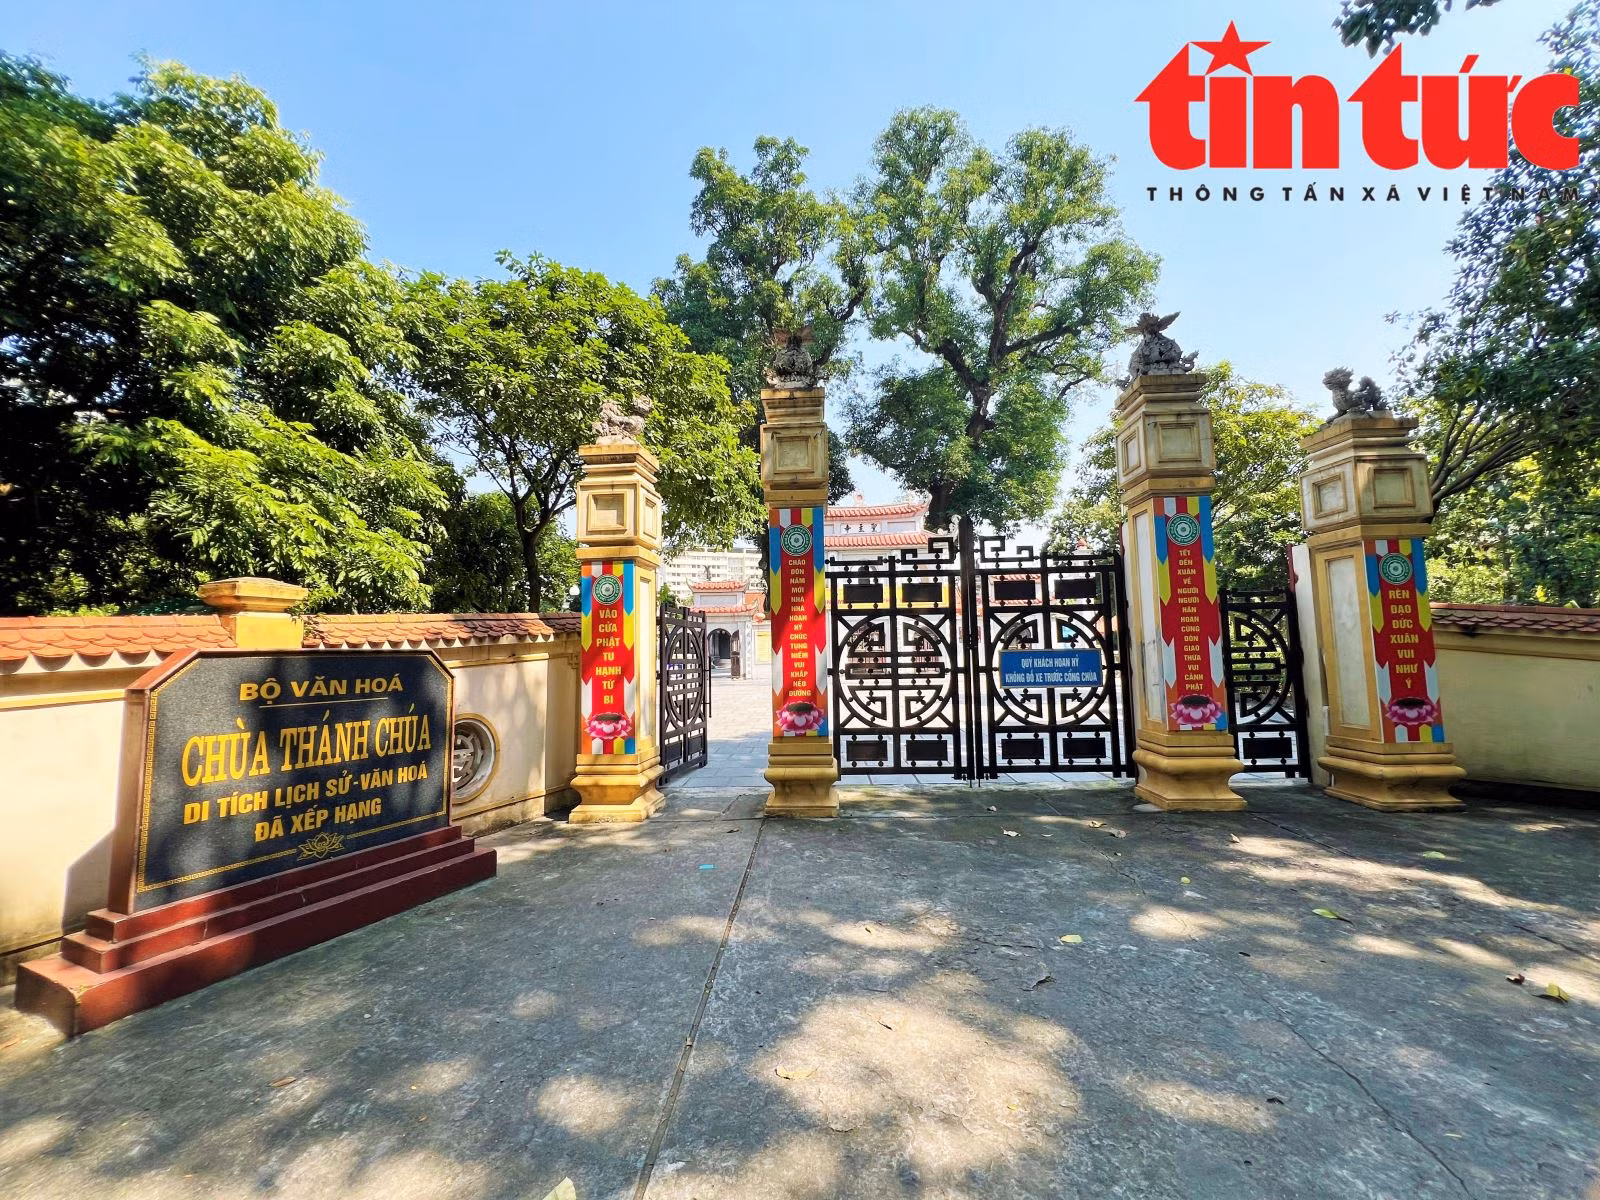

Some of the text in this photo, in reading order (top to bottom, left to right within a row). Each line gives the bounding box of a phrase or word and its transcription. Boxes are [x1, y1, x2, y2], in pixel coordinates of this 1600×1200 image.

[789, 614, 808, 622] HOAN
[1392, 617, 1413, 629] ĐỨC
[598, 621, 618, 632] CỬA
[596, 636, 620, 649] PHẬT
[1390, 633, 1419, 643] XUÂN
[603, 652, 614, 661] TU
[1397, 649, 1415, 658] VUI
[1033, 655, 1053, 668] KHÁCH
[1054, 657, 1070, 667] HOAN
[595, 666, 622, 677] HẠNH
[1396, 663, 1418, 673] NHƯ
[1005, 671, 1025, 683] KHÔNG
[1035, 673, 1043, 682] XE
[1044, 670, 1063, 682] TRƯỚC
[1081, 670, 1098, 682] CHÙA
[239, 672, 403, 704] BỘ VĂN HOÁ
[603, 695, 614, 704] BI
[181, 703, 431, 787] CHÙA THÁNH CHÚA
[183, 801, 209, 825] DI
[217, 790, 268, 818] TÍCH
[274, 782, 320, 808] LỊCH
[397, 760, 428, 784] HOÁ
[255, 797, 382, 843] ĐÃ XẾP HẠNG
